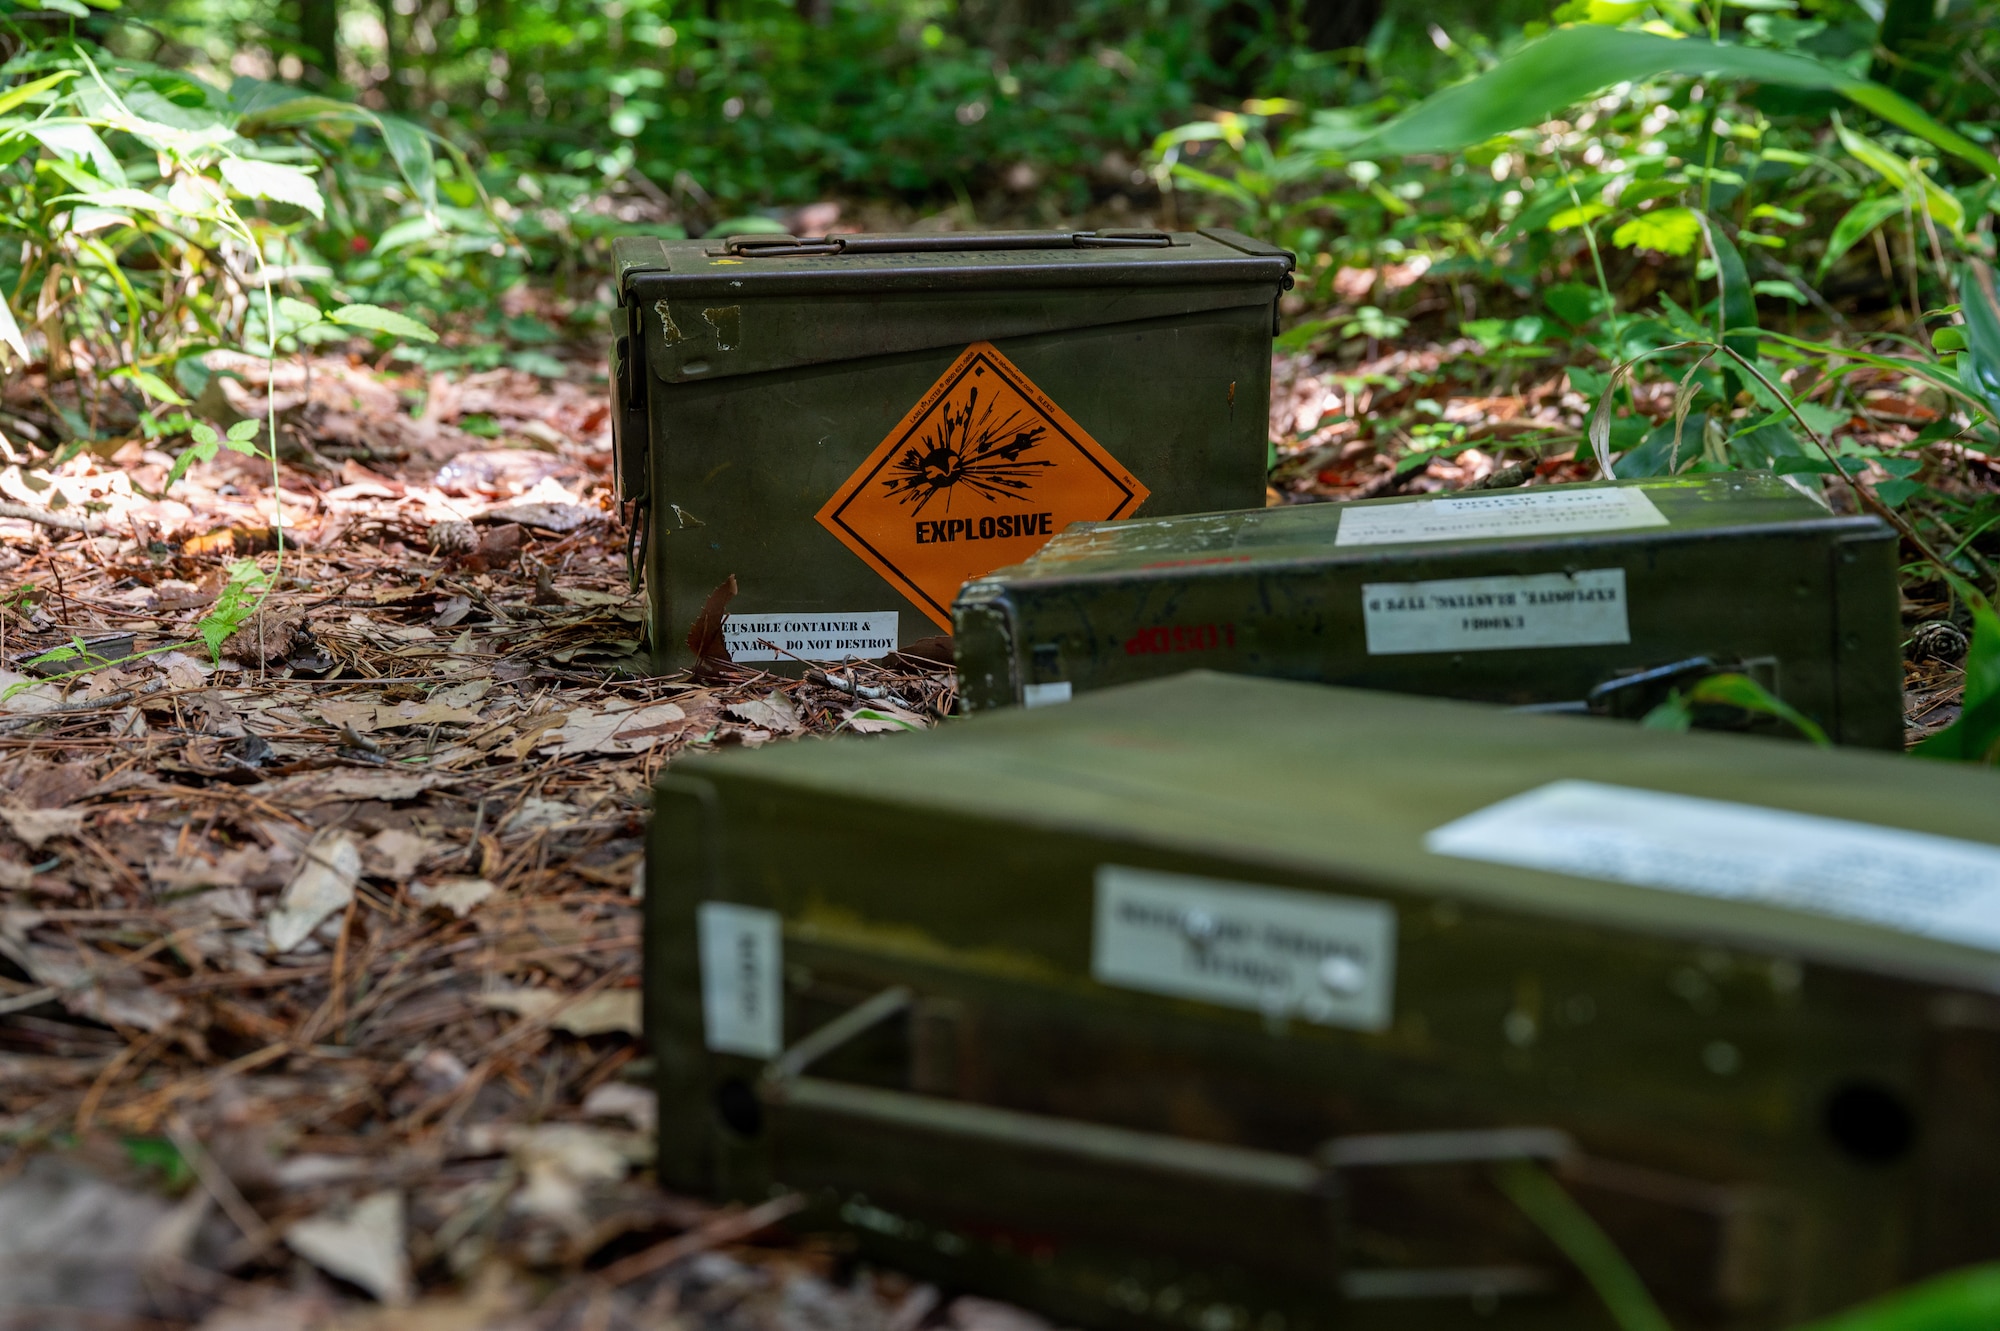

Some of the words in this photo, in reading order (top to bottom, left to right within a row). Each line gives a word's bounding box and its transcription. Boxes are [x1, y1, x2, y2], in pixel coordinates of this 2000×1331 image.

[988, 350, 1034, 394] www.labelmaster.com
[916, 512, 1053, 544] EXPLOSIVE
[723, 623, 781, 633] EUSABLE
[784, 622, 858, 632] CONTAINER
[862, 621, 871, 631] &
[786, 641, 803, 650] DO
[807, 640, 832, 649] NOT
[836, 638, 894, 649] DESTROY
